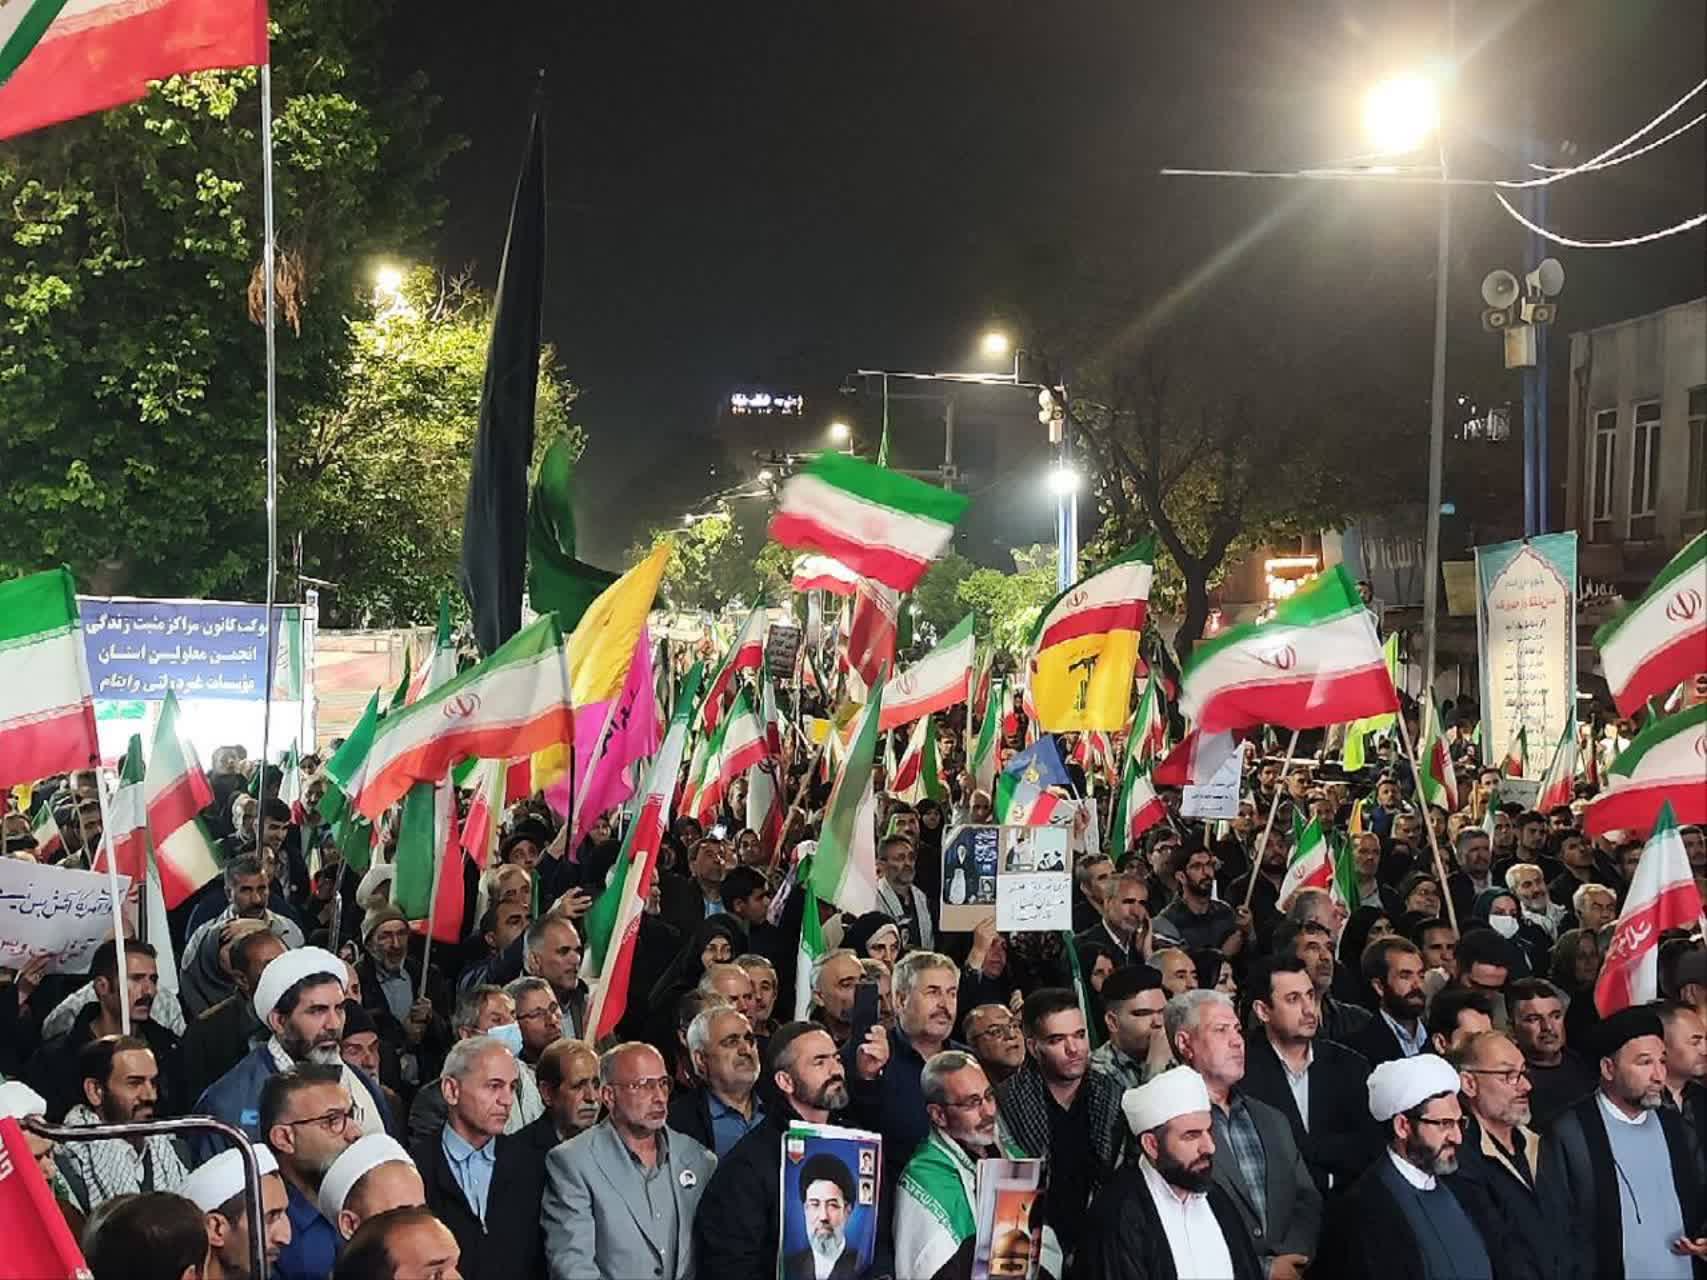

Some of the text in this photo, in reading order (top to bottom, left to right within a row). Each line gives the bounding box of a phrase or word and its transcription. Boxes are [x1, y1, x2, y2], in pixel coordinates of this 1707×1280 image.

[86, 613, 131, 634] زندگی
[133, 615, 165, 634] مثبت
[166, 616, 200, 636] مراکز
[203, 616, 237, 637] کانون
[98, 643, 257, 664] انجمن معلولین استان
